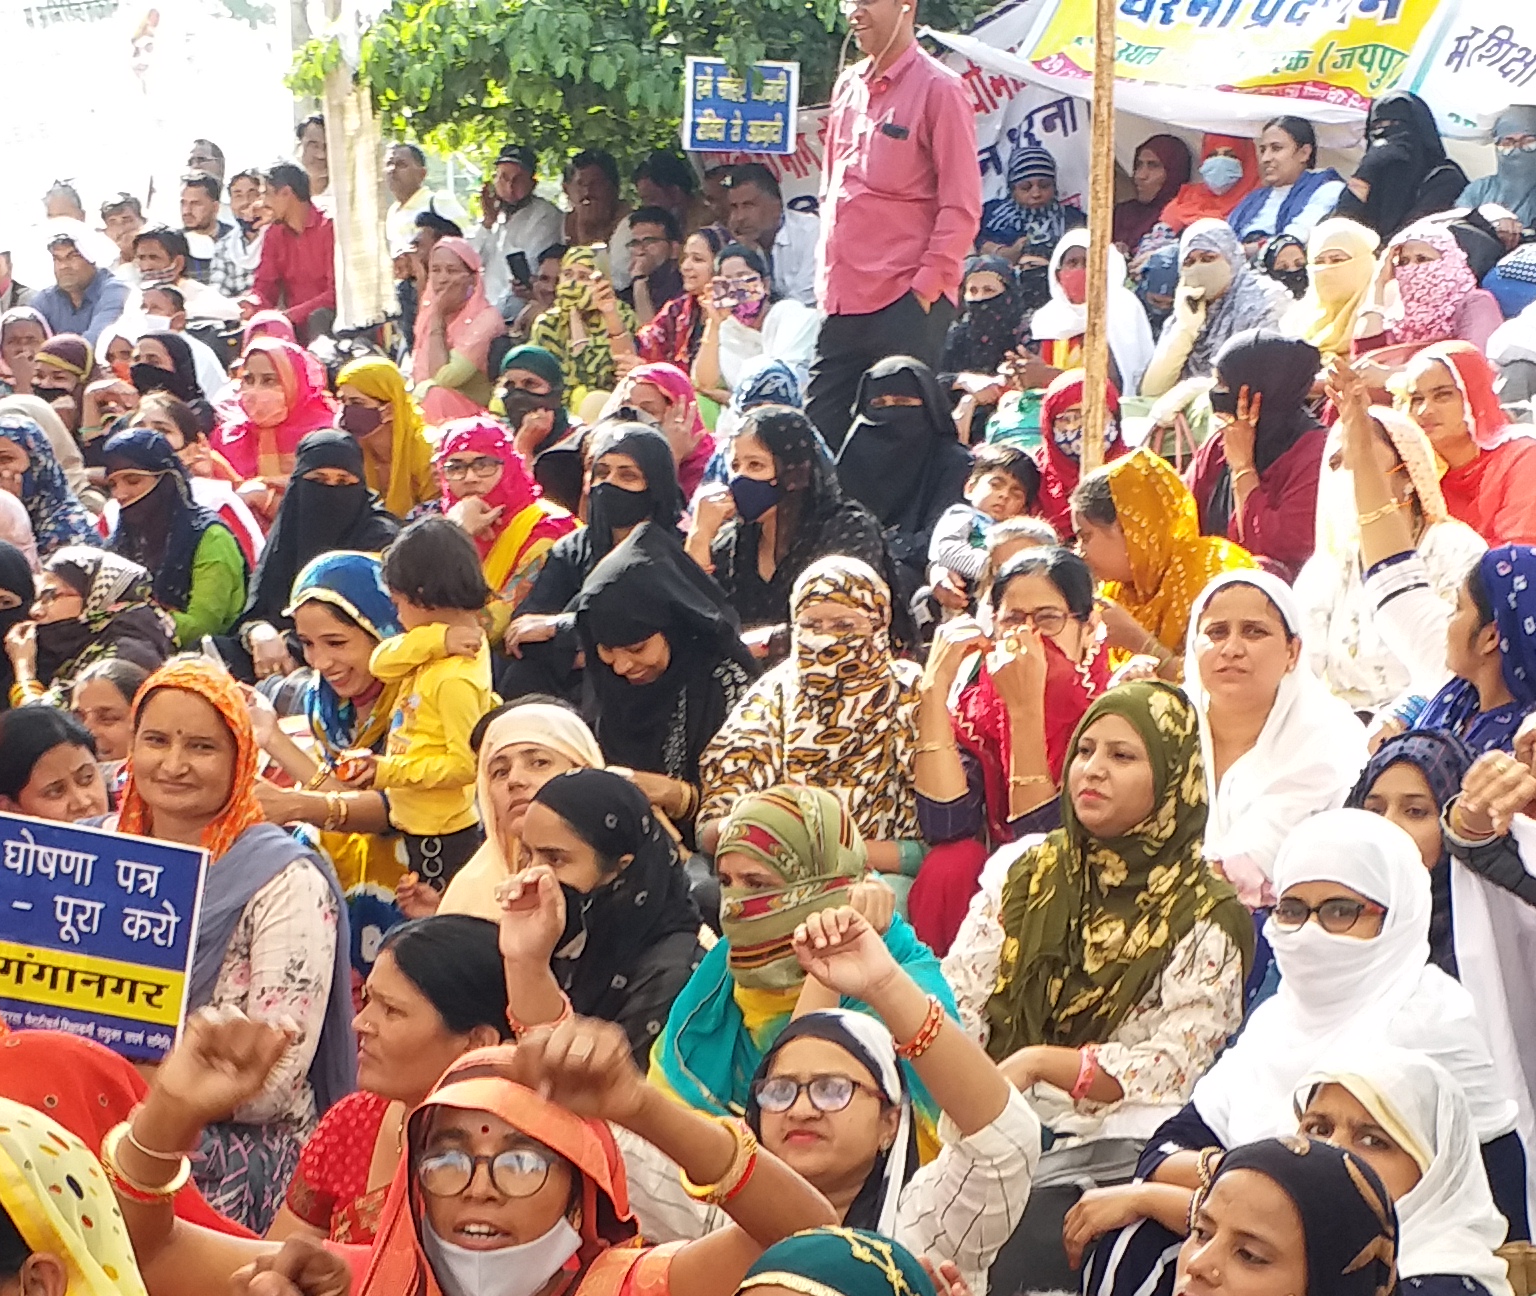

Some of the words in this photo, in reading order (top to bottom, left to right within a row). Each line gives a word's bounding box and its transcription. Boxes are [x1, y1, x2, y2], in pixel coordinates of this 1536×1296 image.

[4, 828, 98, 887] घोषणा
[115, 859, 163, 898] पत्र
[53, 895, 106, 945] पूरा
[122, 900, 181, 948] करो
